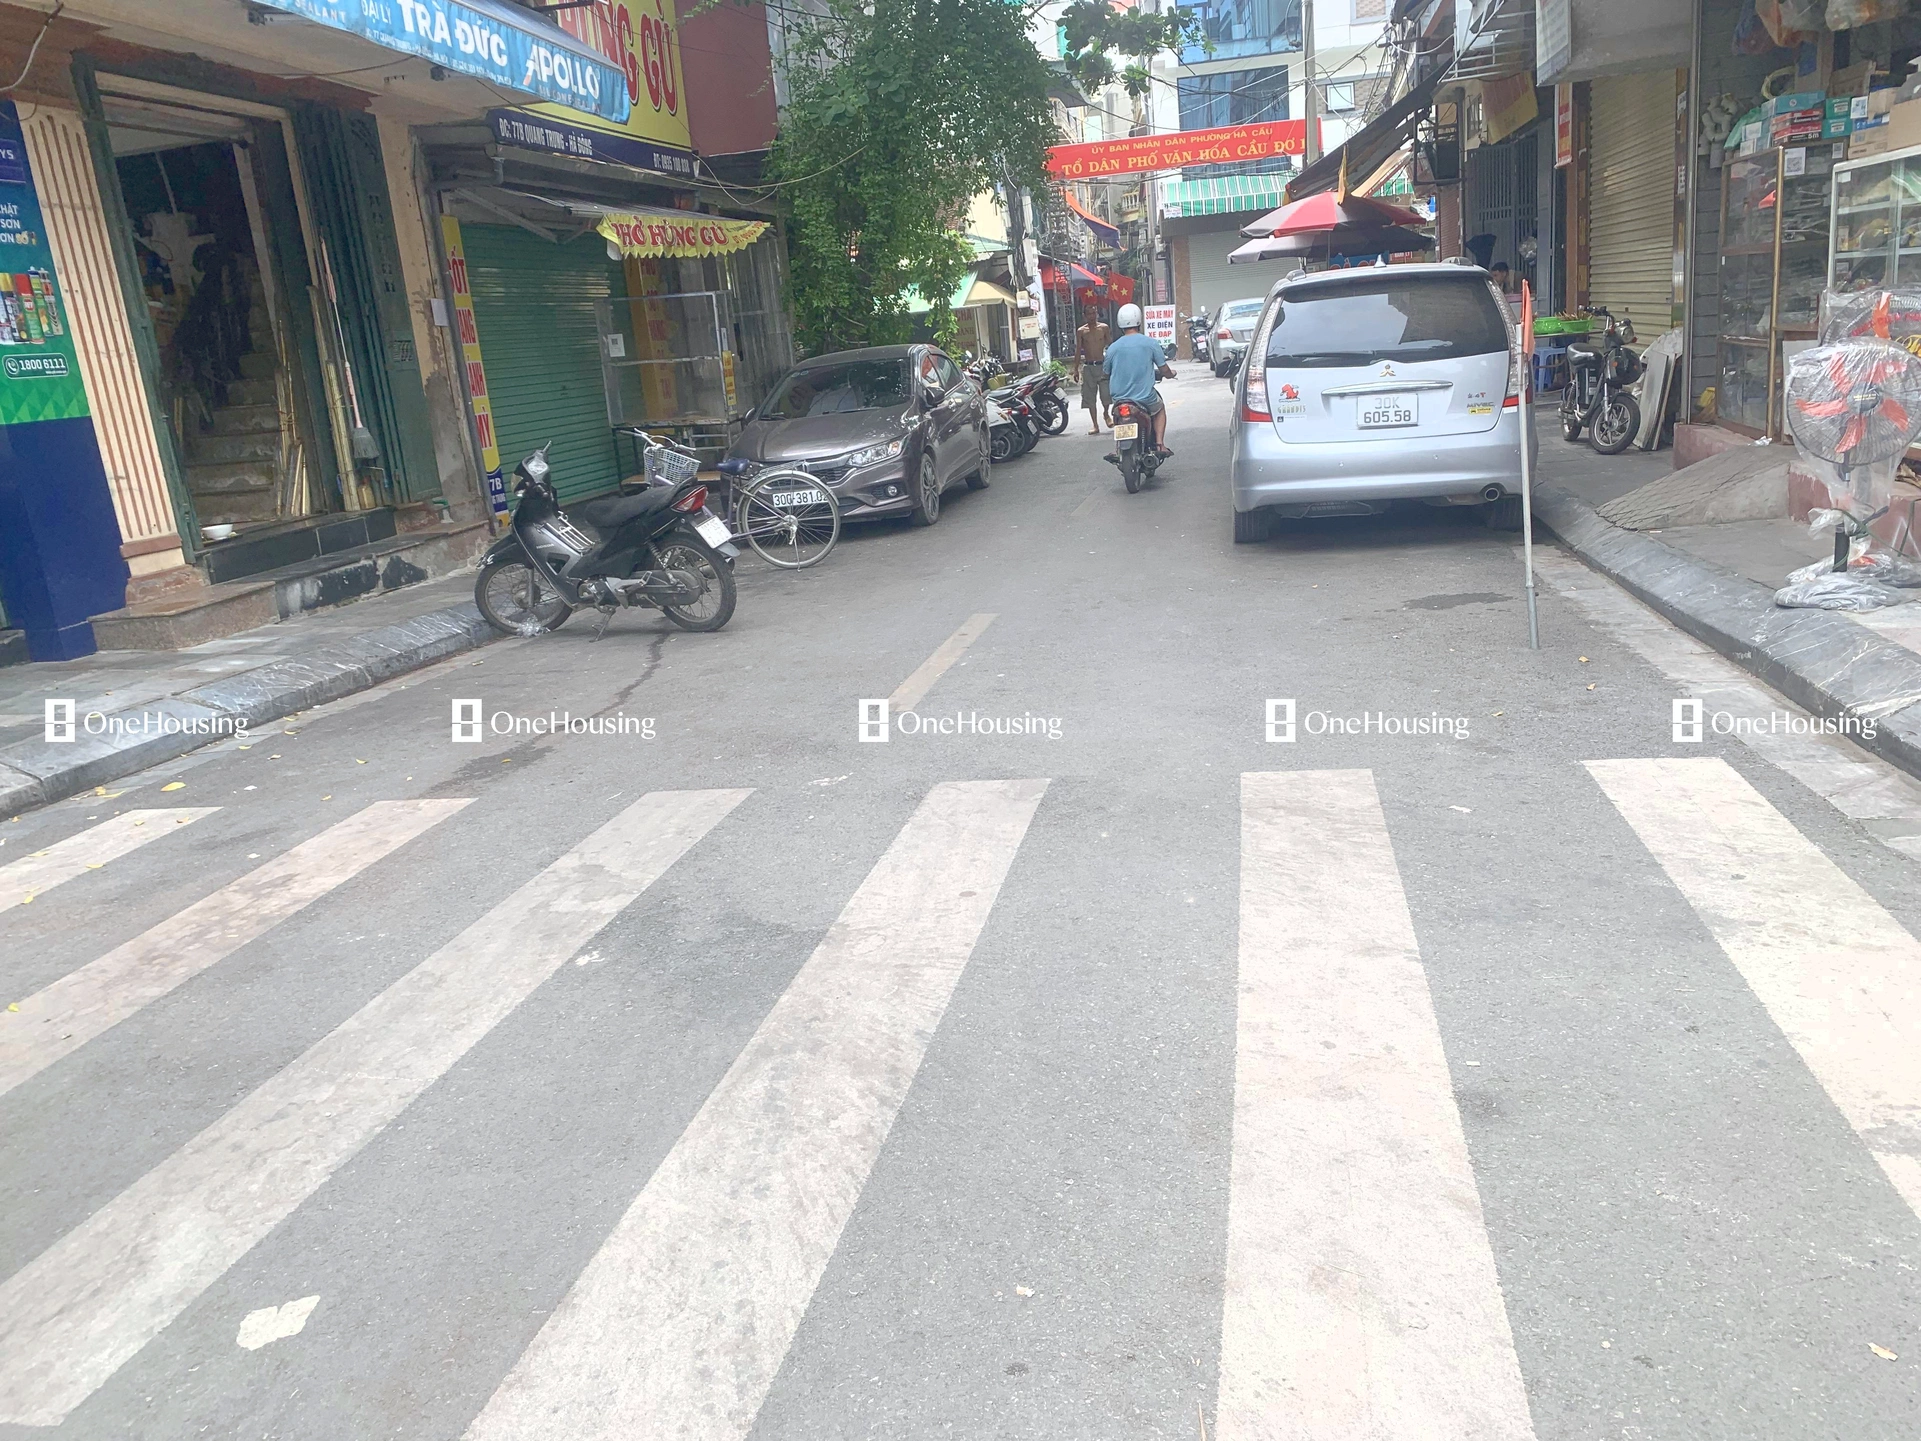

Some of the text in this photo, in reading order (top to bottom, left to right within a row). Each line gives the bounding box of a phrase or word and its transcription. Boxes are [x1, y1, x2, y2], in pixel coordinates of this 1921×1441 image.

[396, 0, 453, 48] TRÀ
[454, 17, 508, 67] ĐỨC
[523, 43, 600, 100] APOLLO
[524, 123, 546, 146] QUANG
[545, 128, 565, 150] TRUNG
[568, 130, 578, 153] HÀ
[1091, 126, 1273, 154] ỦY BAN NHÂN DÂN PHƯỜNG HÀ CẦU
[1062, 157, 1082, 176] TỔ
[1089, 157, 1120, 172] DÂN
[1127, 149, 1158, 168] PHỐ
[1162, 148, 1192, 164] VĂN
[1198, 143, 1231, 160] HÓA
[1237, 138, 1267, 156] CẦU
[1273, 137, 1296, 153] ĐƠ
[1157, 320, 1173, 330] ĐIỆN
[19, 358, 66, 371] 1800 6111
[1363, 409, 1412, 424] 605.58
[1374, 396, 1400, 410] 30K
